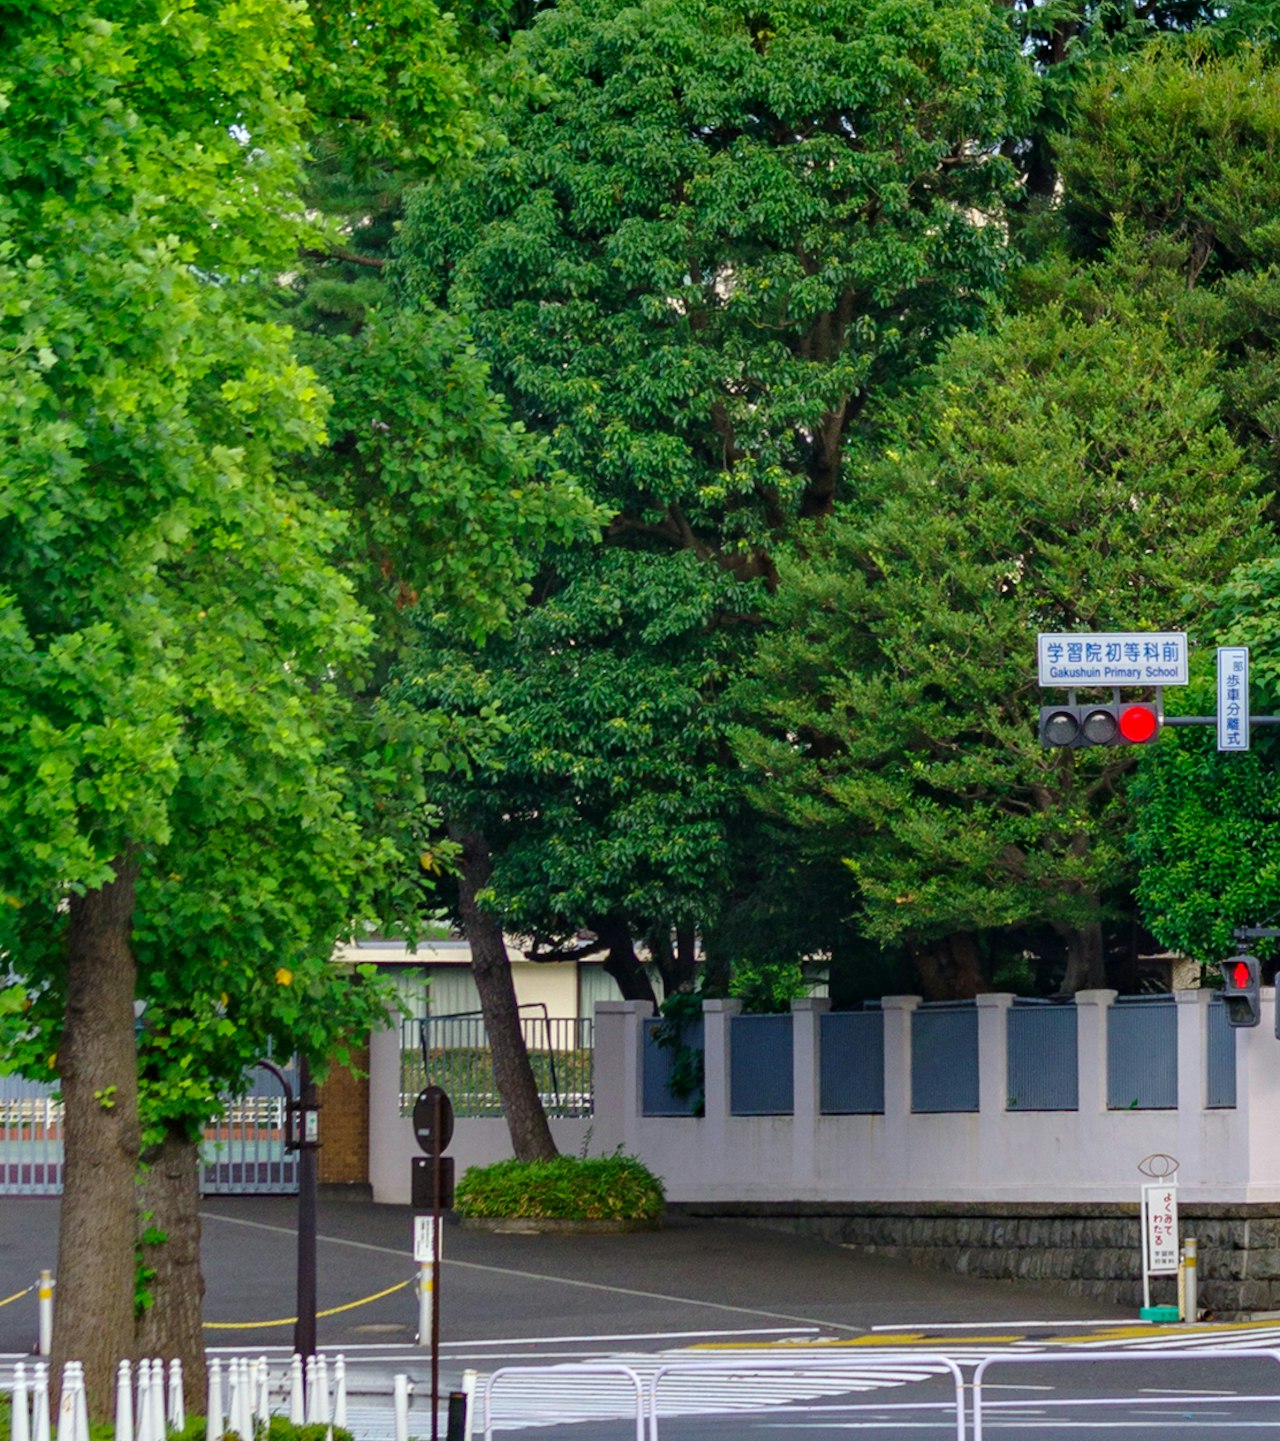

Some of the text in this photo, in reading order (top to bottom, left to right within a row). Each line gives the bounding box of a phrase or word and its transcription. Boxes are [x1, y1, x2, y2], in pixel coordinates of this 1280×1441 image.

[1047, 641, 1179, 663] 学習院初等科前
[1232, 655, 1244, 672] 一部
[1050, 666, 1178, 679] Gakushuin Primary School
[1226, 674, 1241, 746] 歩車分離式
[1163, 1192, 1173, 1236] よくみて
[1153, 1214, 1163, 1246] わたる
